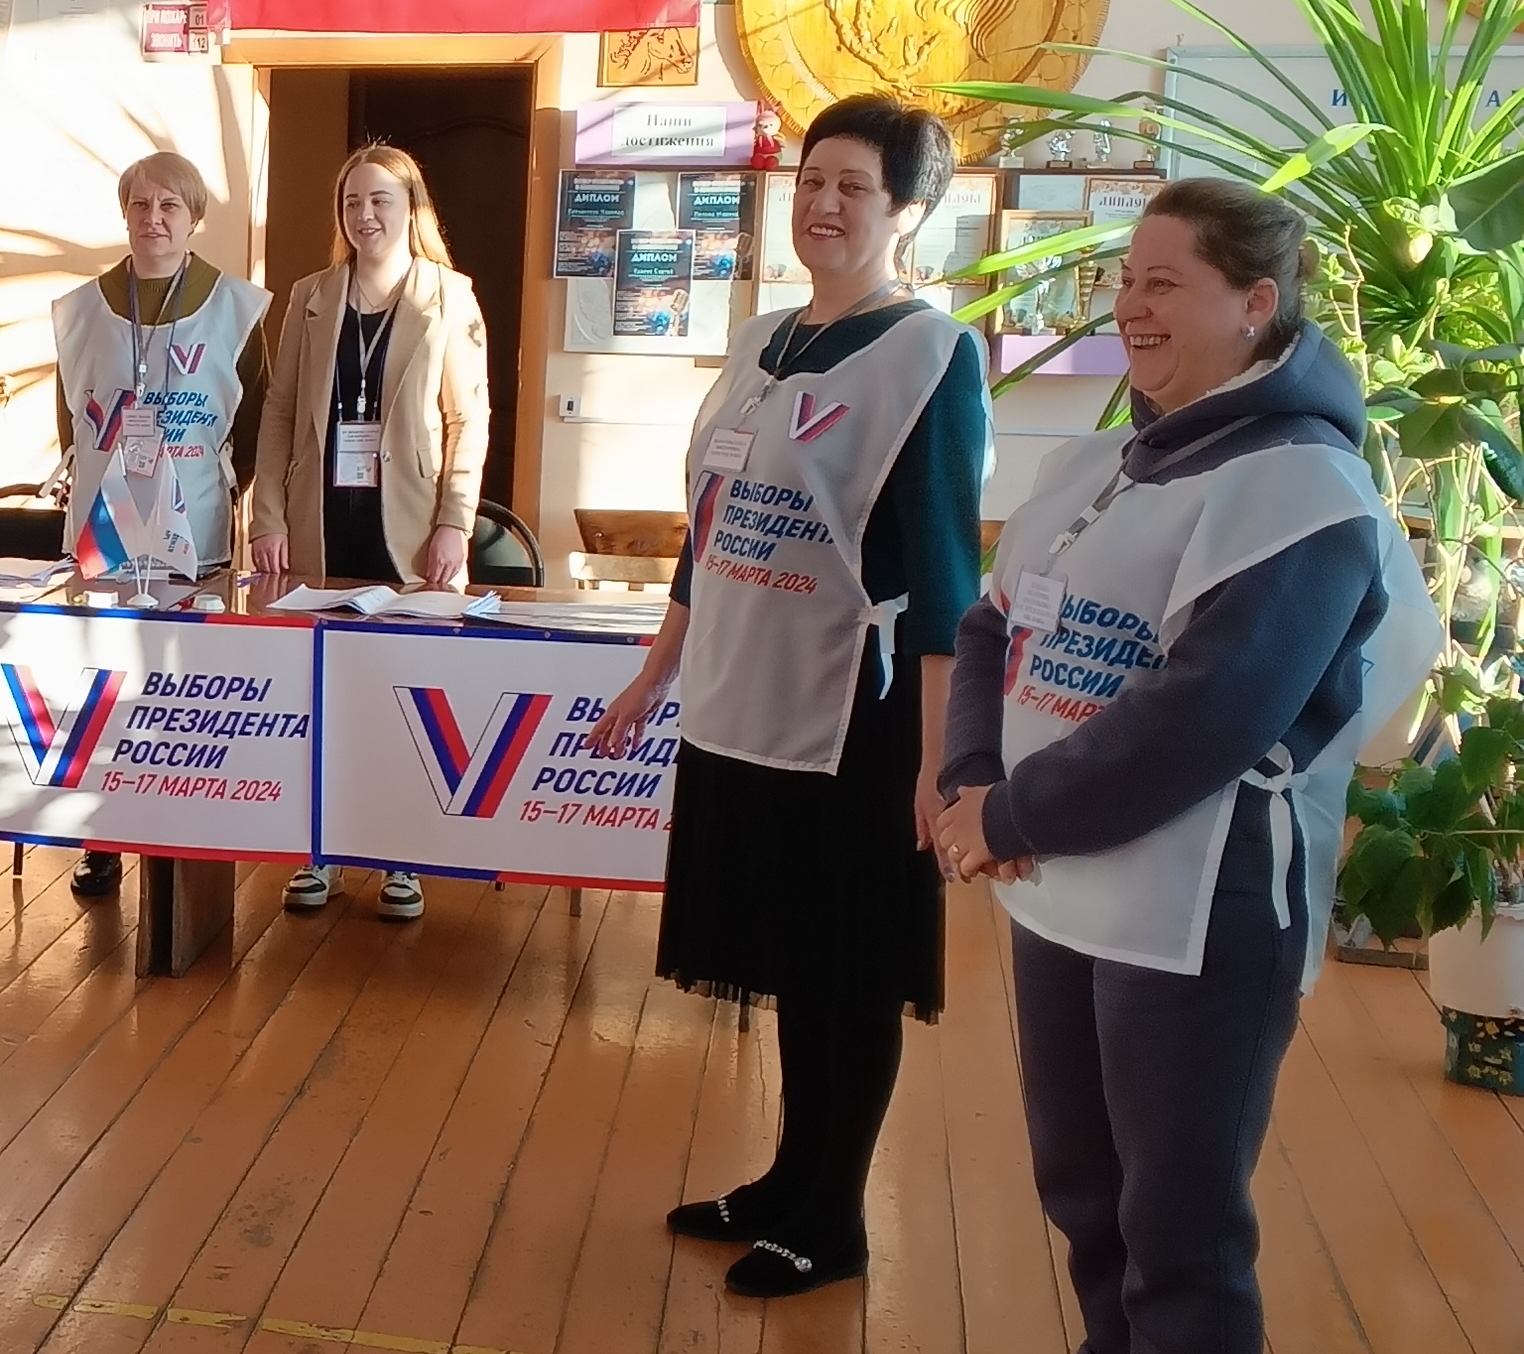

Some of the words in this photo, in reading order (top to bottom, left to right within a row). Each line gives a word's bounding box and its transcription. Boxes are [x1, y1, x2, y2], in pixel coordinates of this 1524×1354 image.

[647, 114, 692, 127] Наши
[621, 136, 714, 147] достижения
[574, 193, 620, 203] ДИПЛОМ
[693, 195, 740, 206] ДИПЛОМ
[630, 253, 678, 262] ДИПЛОМ
[730, 479, 814, 512] ВЫБОРЫ
[713, 530, 778, 561] РОССИИ
[730, 560, 771, 587] МАРТА
[772, 572, 819, 595] 2024
[141, 671, 273, 703] ВЫБОРЫ
[1029, 653, 1126, 698] РОССИИ
[126, 705, 310, 740] ПРЕЗИДЕНТА
[111, 739, 229, 770] РОССИИ
[157, 775, 227, 800] МАРТА
[229, 779, 282, 802] 2024
[532, 766, 662, 799] РОССИИ
[582, 804, 660, 830] МАРТА
